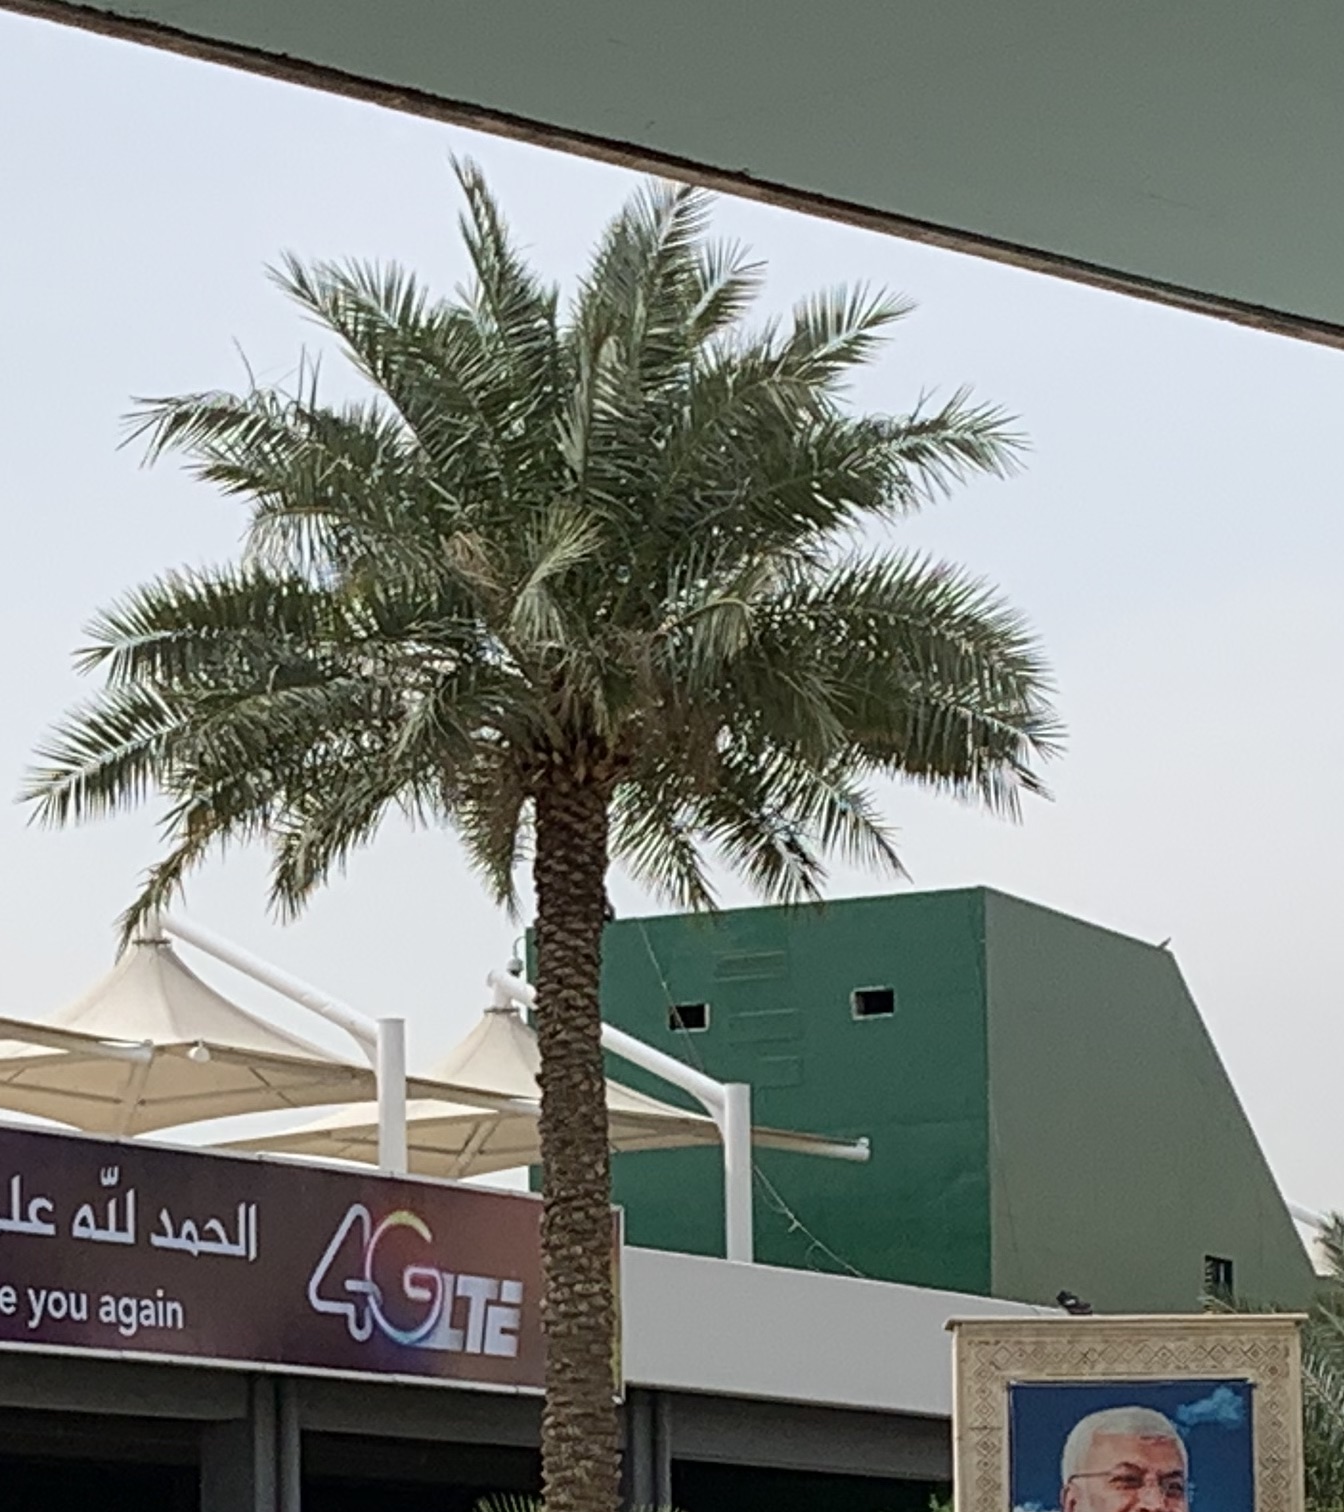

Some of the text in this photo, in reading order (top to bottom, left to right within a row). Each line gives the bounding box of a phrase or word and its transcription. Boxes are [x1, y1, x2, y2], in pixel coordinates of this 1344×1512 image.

[150, 1202, 257, 1262] الحمد
[27, 1287, 88, 1330] you
[98, 1289, 185, 1337] again
